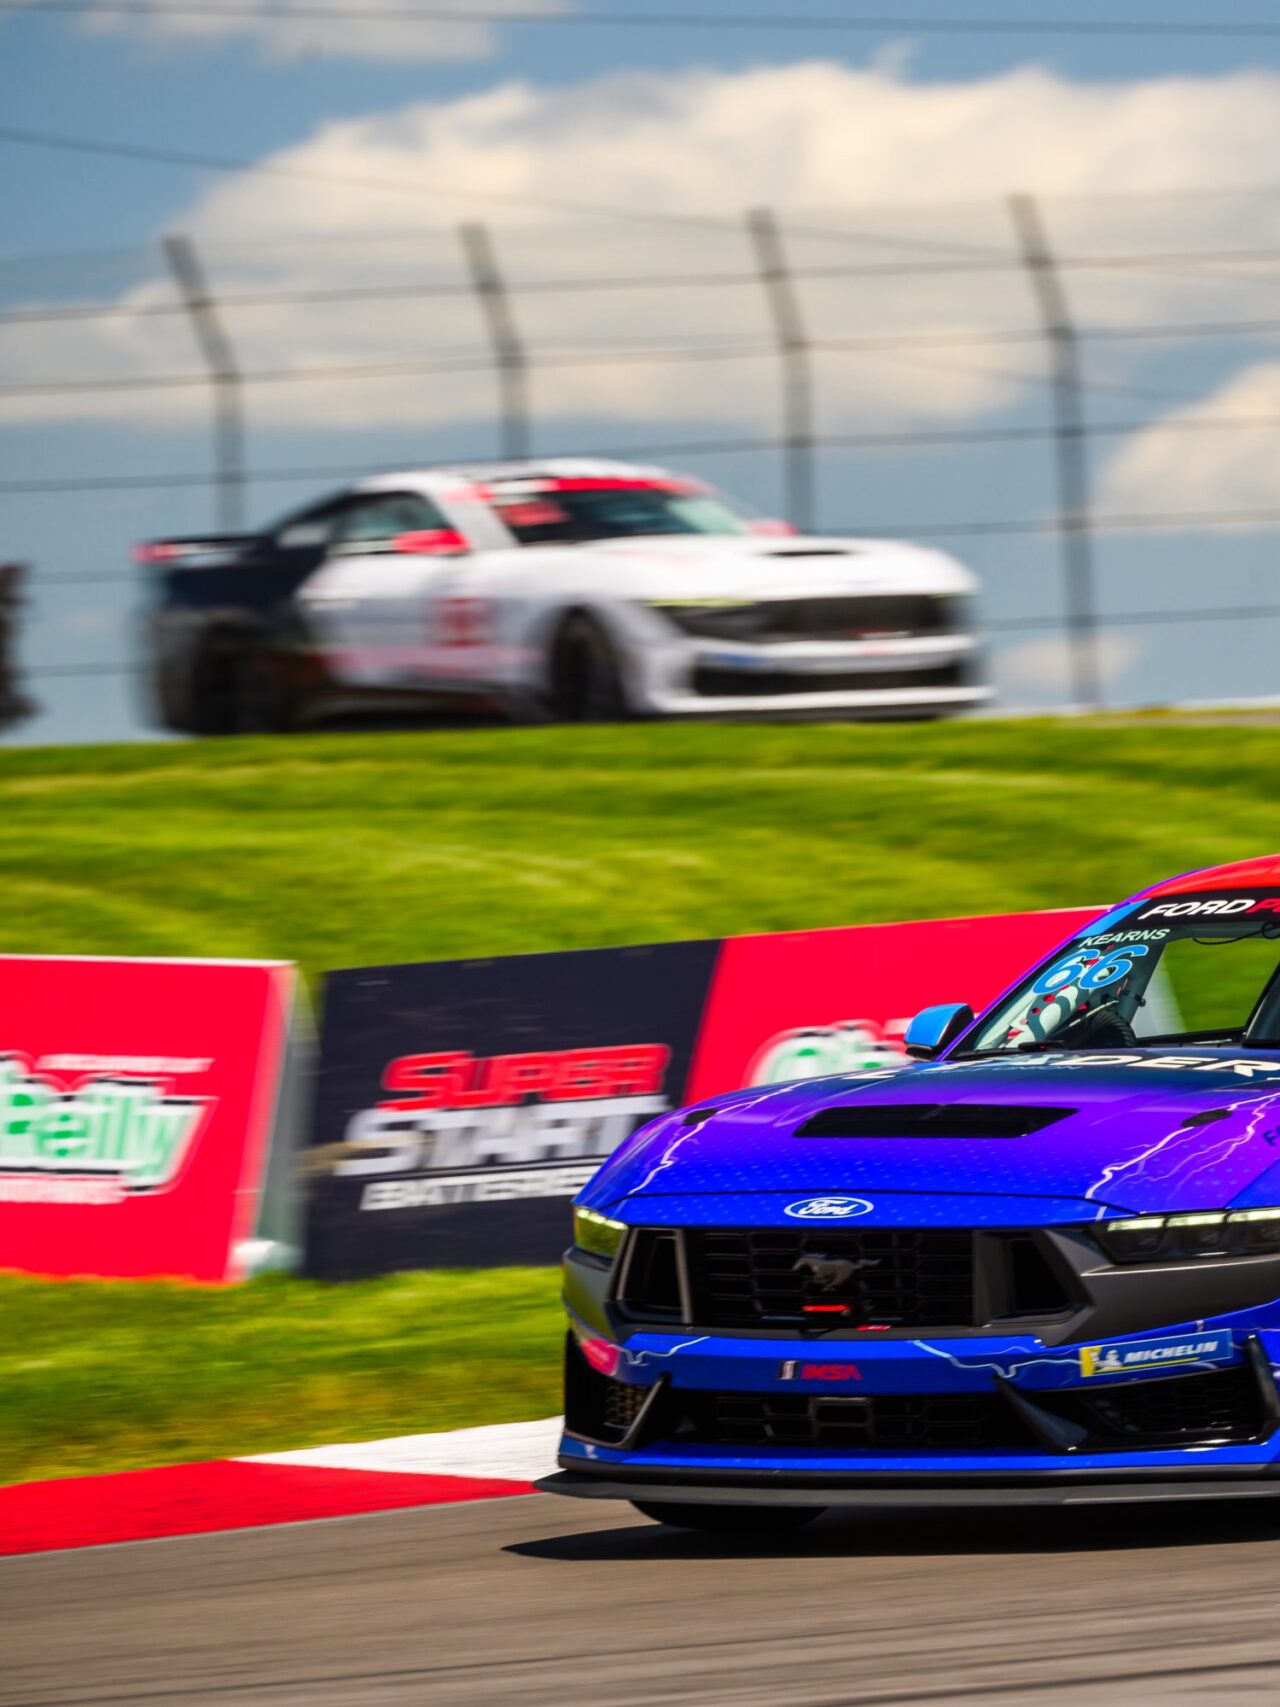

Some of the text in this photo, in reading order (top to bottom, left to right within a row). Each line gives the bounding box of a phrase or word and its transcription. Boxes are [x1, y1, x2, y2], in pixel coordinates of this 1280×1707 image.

[1078, 928, 1170, 948] KEARNS
[1032, 944, 1149, 994] 66
[374, 1042, 672, 1112] SUPER
[798, 1199, 859, 1216] Ford
[1124, 1341, 1219, 1363] MICHELIN
